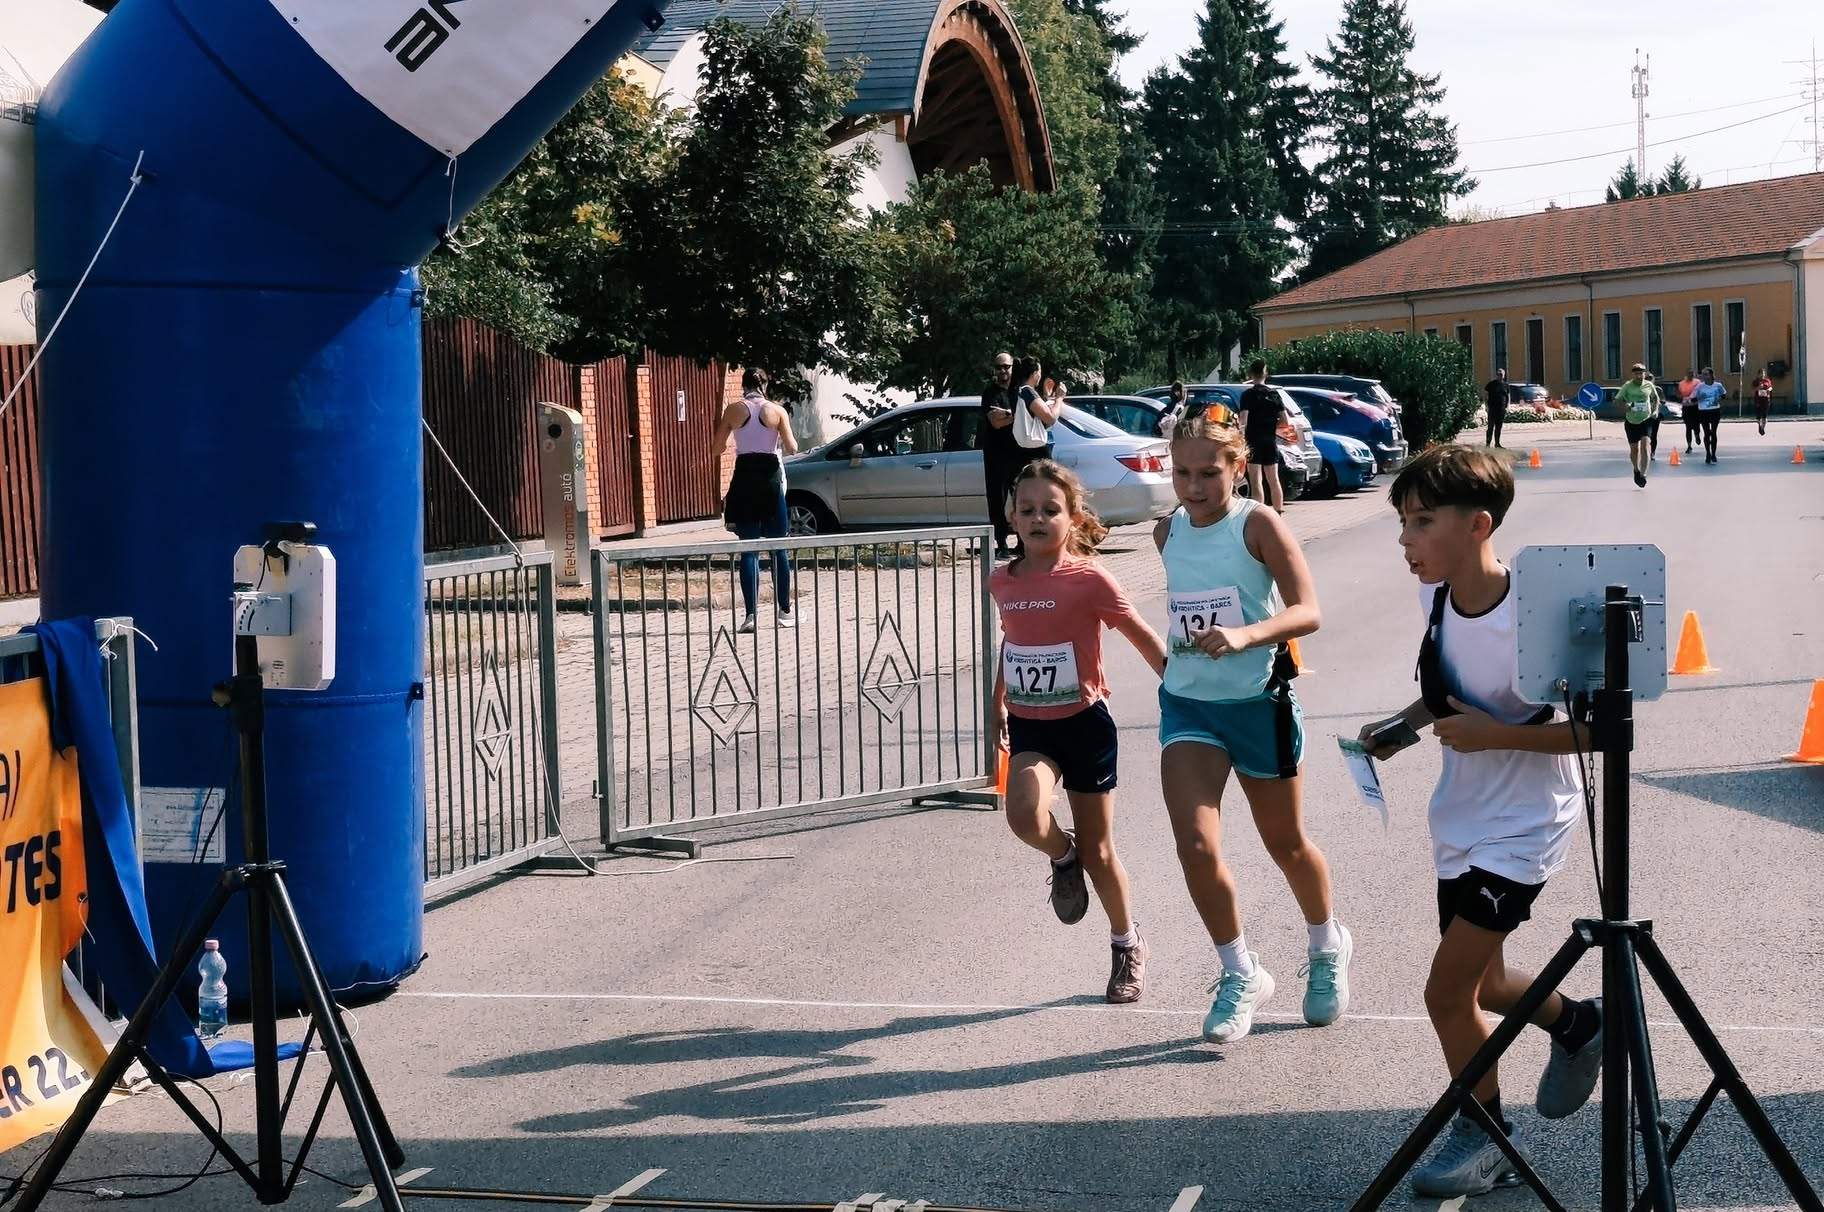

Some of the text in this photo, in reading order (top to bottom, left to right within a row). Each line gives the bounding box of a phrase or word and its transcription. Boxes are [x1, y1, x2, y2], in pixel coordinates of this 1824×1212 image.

[1003, 600, 1056, 610] NIKE PRO
[1015, 666, 1057, 693] 127
